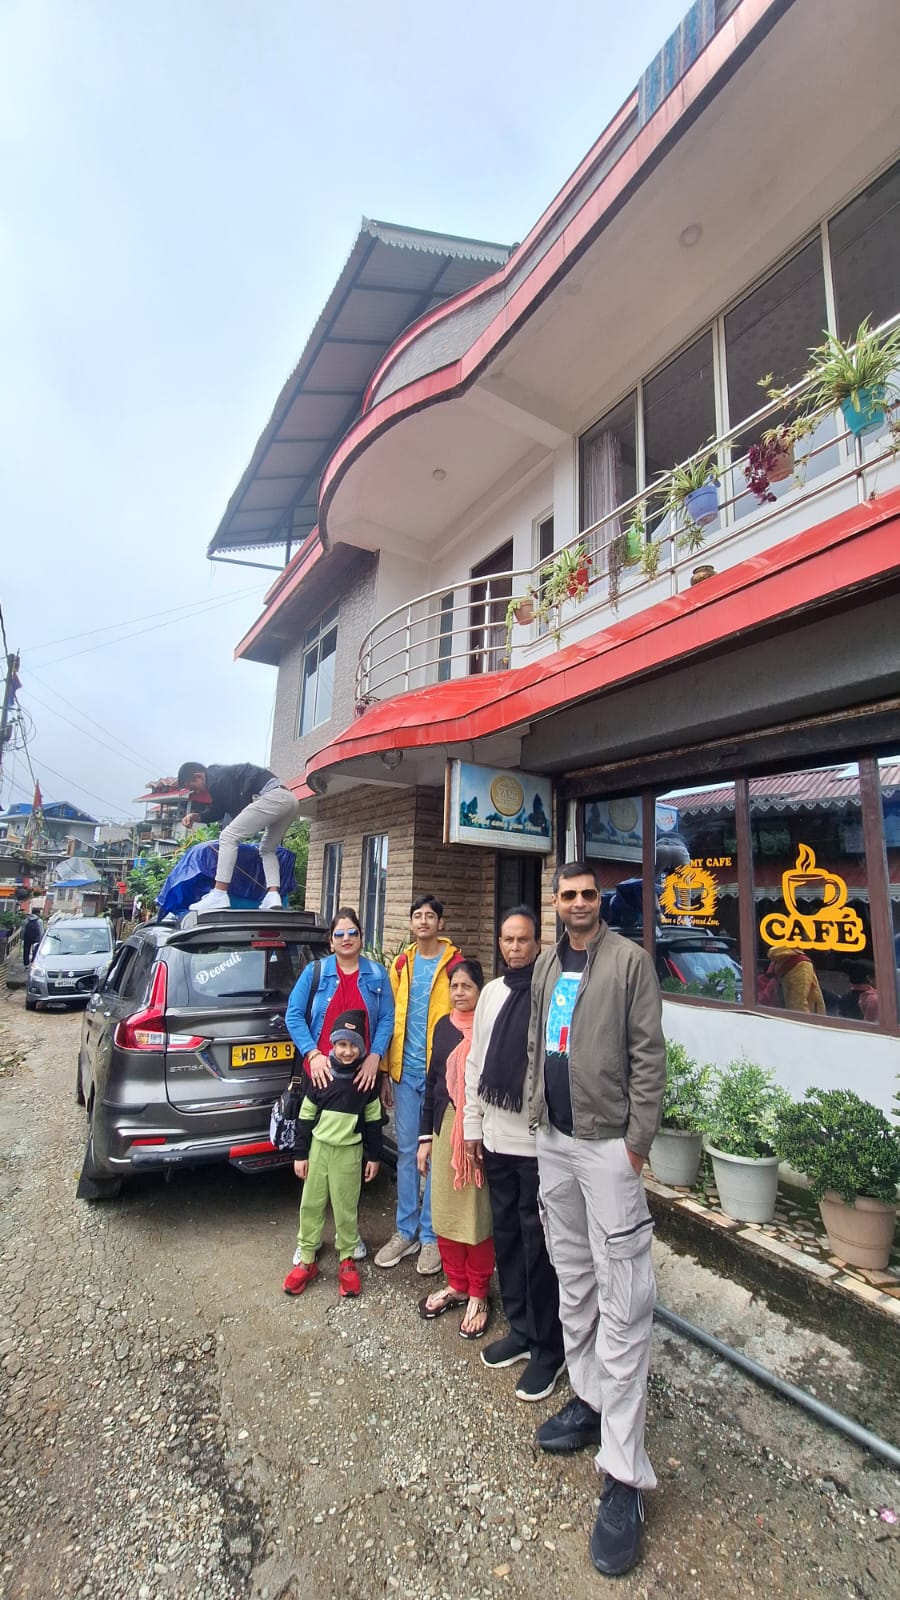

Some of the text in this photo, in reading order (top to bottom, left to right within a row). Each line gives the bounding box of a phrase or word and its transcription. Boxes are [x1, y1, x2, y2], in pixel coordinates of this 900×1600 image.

[706, 856, 732, 867] CAFE
[765, 913, 860, 945] CAFÉ
[241, 1047, 256, 1061] WB
[264, 1045, 278, 1059] 78
